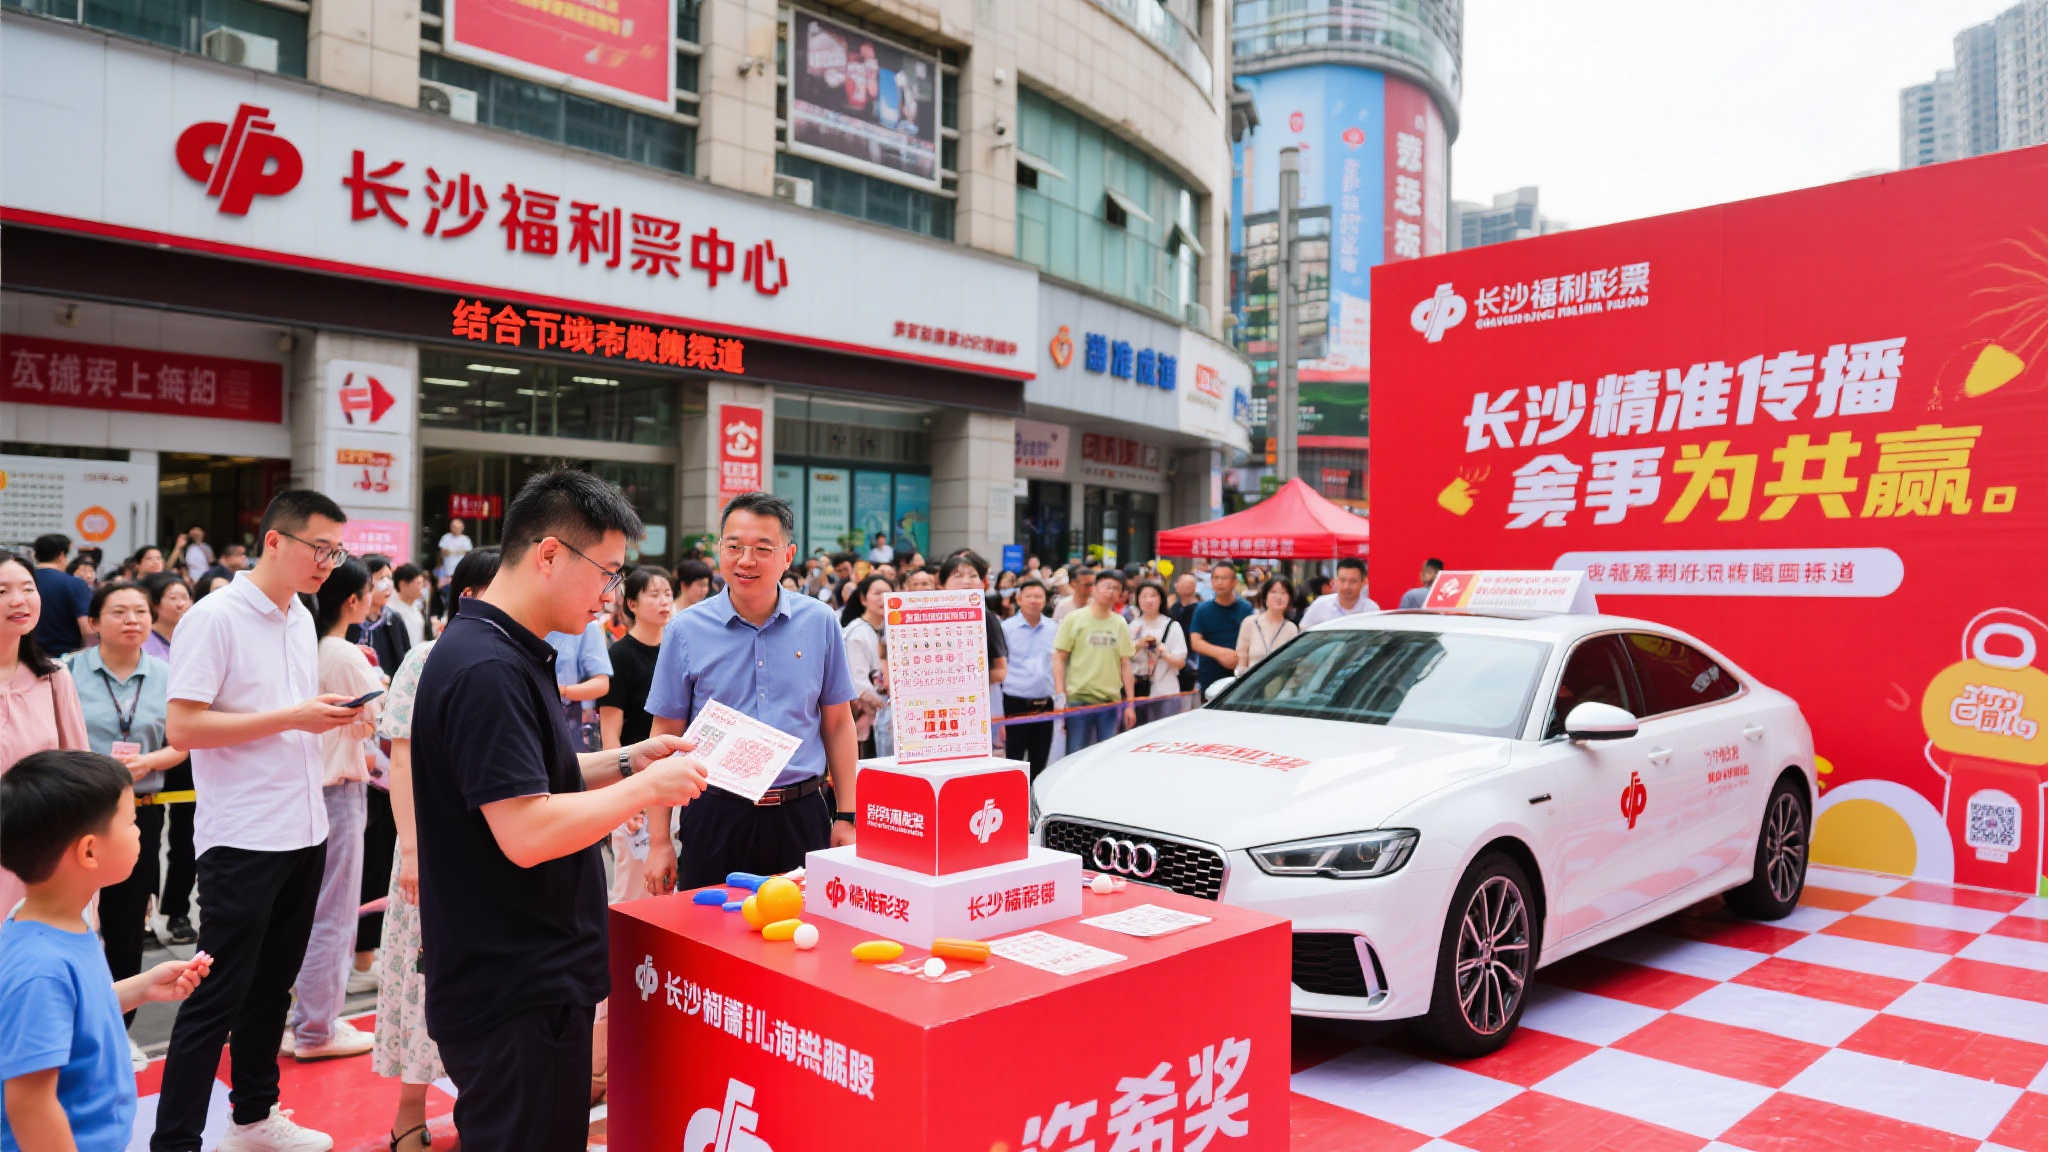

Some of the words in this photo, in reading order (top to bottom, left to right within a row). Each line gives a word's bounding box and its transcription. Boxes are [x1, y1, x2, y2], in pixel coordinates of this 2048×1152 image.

[1474, 262, 1650, 317] 长沙福利彩票
[1463, 337, 1908, 453] 长沙精准传播
